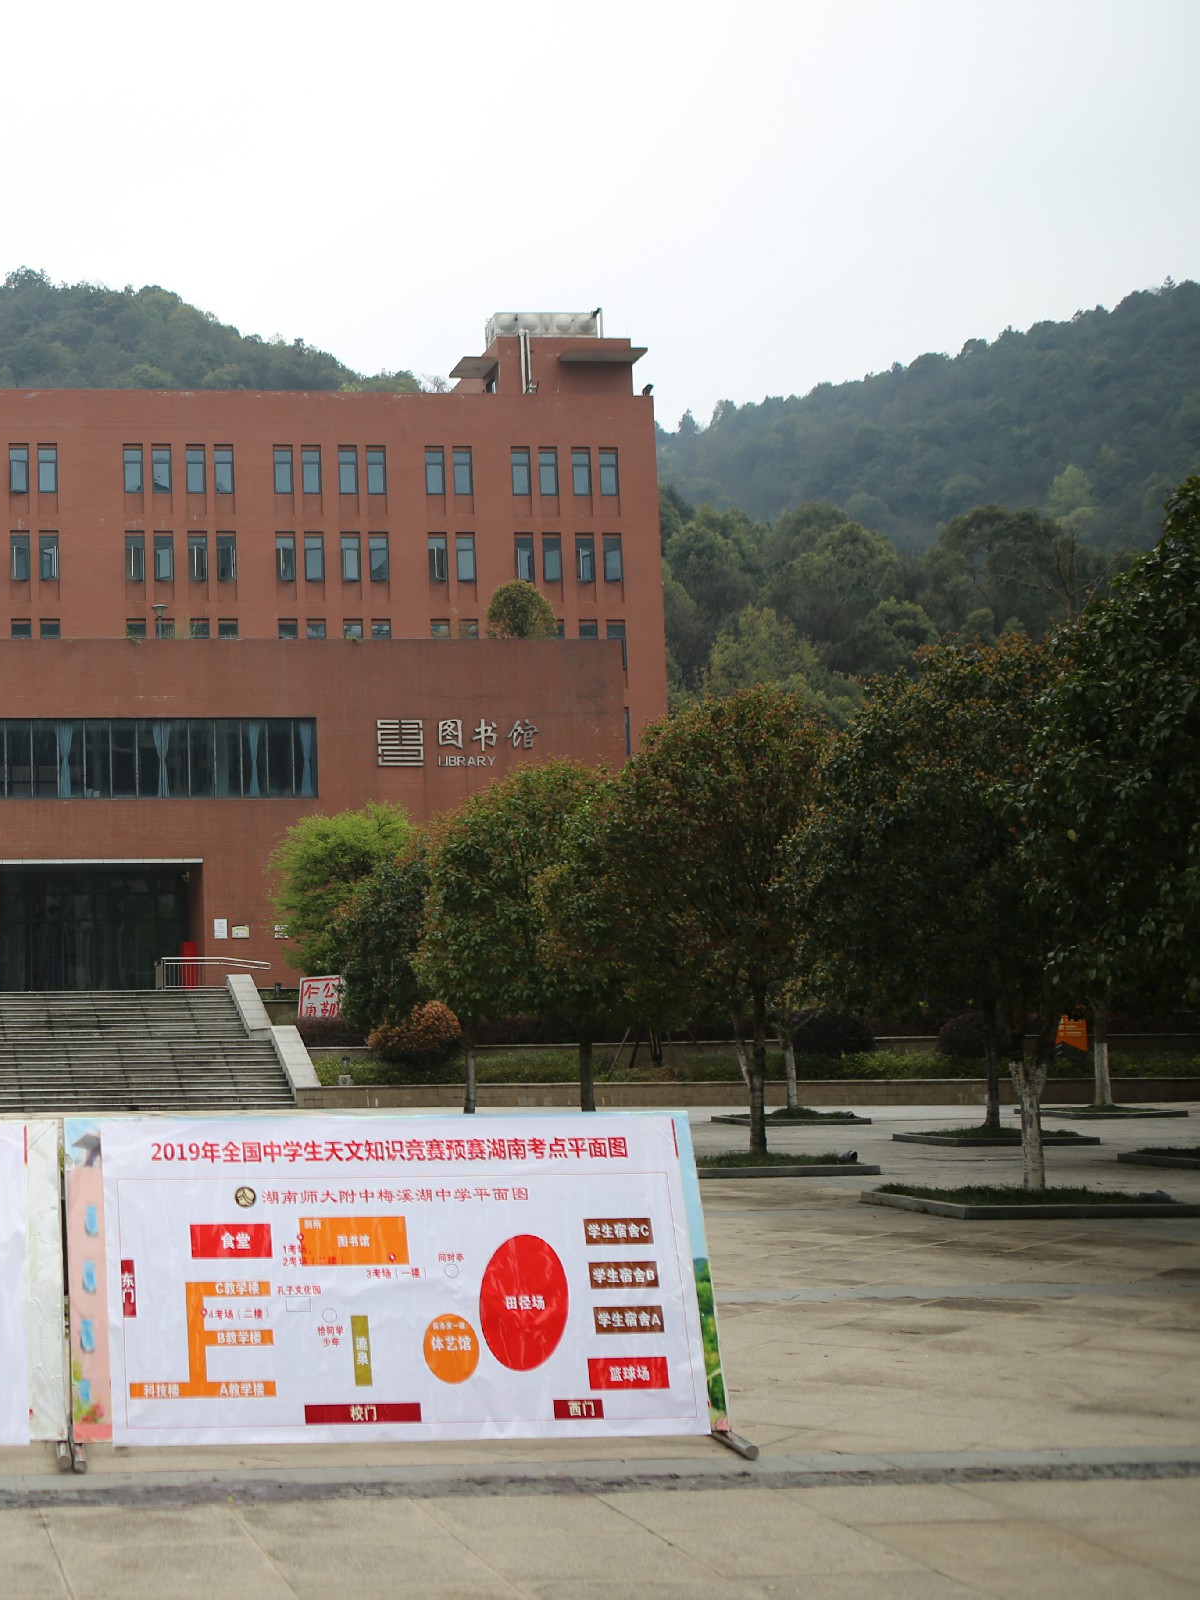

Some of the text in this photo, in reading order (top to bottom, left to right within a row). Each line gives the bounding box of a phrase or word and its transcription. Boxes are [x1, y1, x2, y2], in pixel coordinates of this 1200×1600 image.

[438, 718, 540, 751] 图书馆
[438, 756, 496, 767] LIBRARY
[151, 1136, 628, 1164] 2019年全国中学生天文知识竞赛预赛湖南考点平面图
[262, 1187, 529, 1204] 湖南师大附中梅溪湖中学平面图
[304, 1220, 322, 1230] 厕所
[588, 1224, 650, 1239] 学生宿舍C
[220, 1232, 251, 1250] 食堂
[337, 1235, 370, 1248] 图书馆
[366, 1267, 426, 1279] 3考场（一楼）
[592, 1268, 654, 1283] 学生宿舍B
[121, 1272, 136, 1304] 东门
[215, 1282, 260, 1296] C教学楼
[276, 1285, 322, 1296] 孔子文化园
[504, 1295, 546, 1311] 田径场
[208, 1308, 270, 1320] 4考场（二楼）
[598, 1312, 661, 1328] 学生宿舍A
[217, 1331, 262, 1344] B教学楼
[318, 1326, 344, 1336] 恰同学
[323, 1338, 340, 1348] 少年
[432, 1336, 472, 1352] 体艺馆
[609, 1366, 650, 1382] 篮球场
[143, 1383, 180, 1398] 科技楼
[220, 1383, 264, 1398] A教学楼
[350, 1406, 378, 1422] 校门
[568, 1401, 595, 1417] 西门
